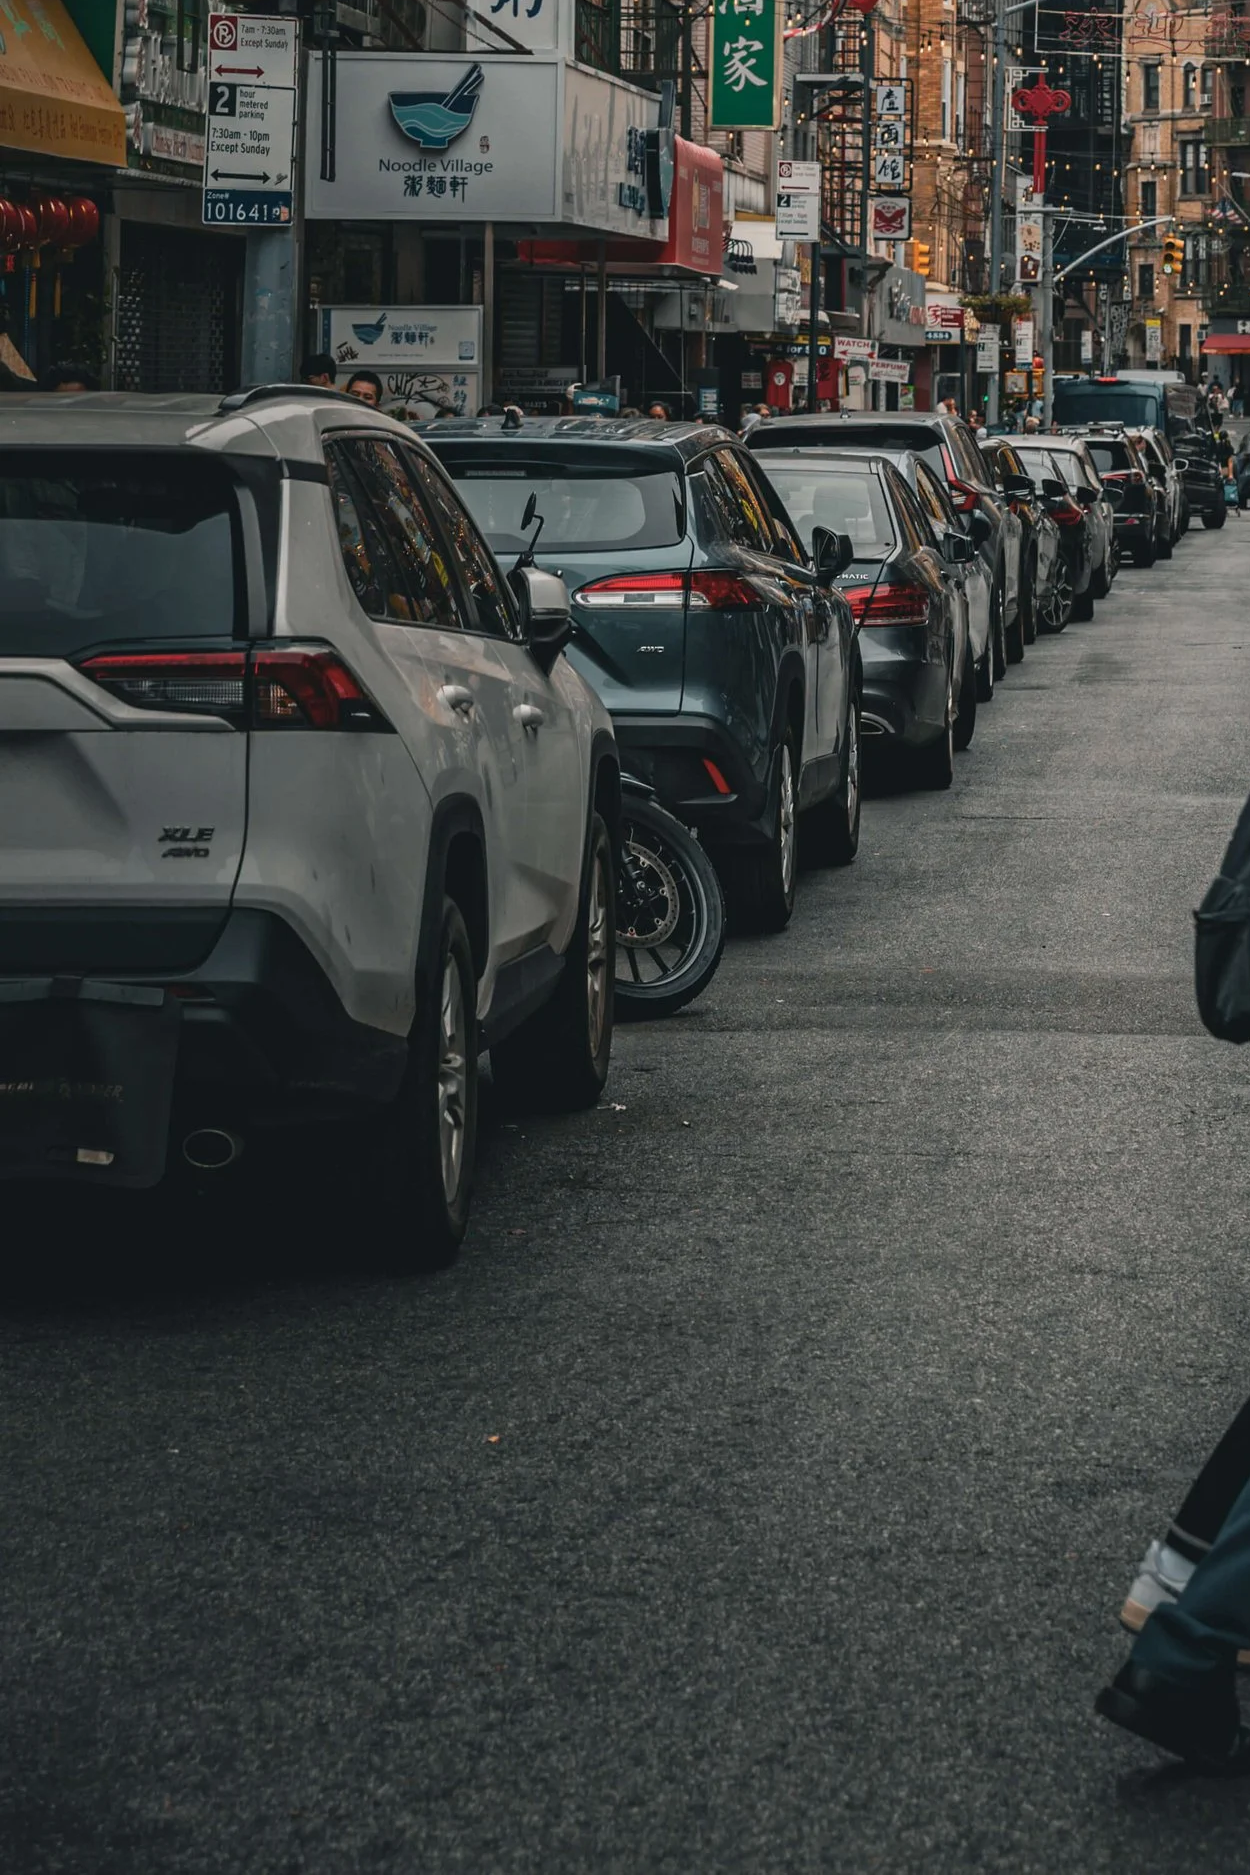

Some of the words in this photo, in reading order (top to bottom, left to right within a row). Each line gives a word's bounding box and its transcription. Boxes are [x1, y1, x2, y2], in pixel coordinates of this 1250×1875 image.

[241, 25, 255, 34] 7am
[261, 26, 286, 36] 7:30am
[241, 38, 263, 49] Except
[265, 39, 288, 51] Sunday
[215, 86, 229, 113] 2
[240, 89, 256, 99] hour
[239, 101, 268, 110] metered
[239, 110, 265, 121] parking
[211, 128, 241, 139] 7:30am
[249, 130, 270, 142] 10pm
[211, 142, 238, 154] Except
[240, 142, 270, 157] Sunday
[379, 159, 437, 172] Noodle
[440, 160, 493, 176] Village
[206, 203, 268, 221] 101641
[786, 344, 802, 354] for
[871, 361, 908, 372] PERFUME
[158, 827, 215, 842] XLE
